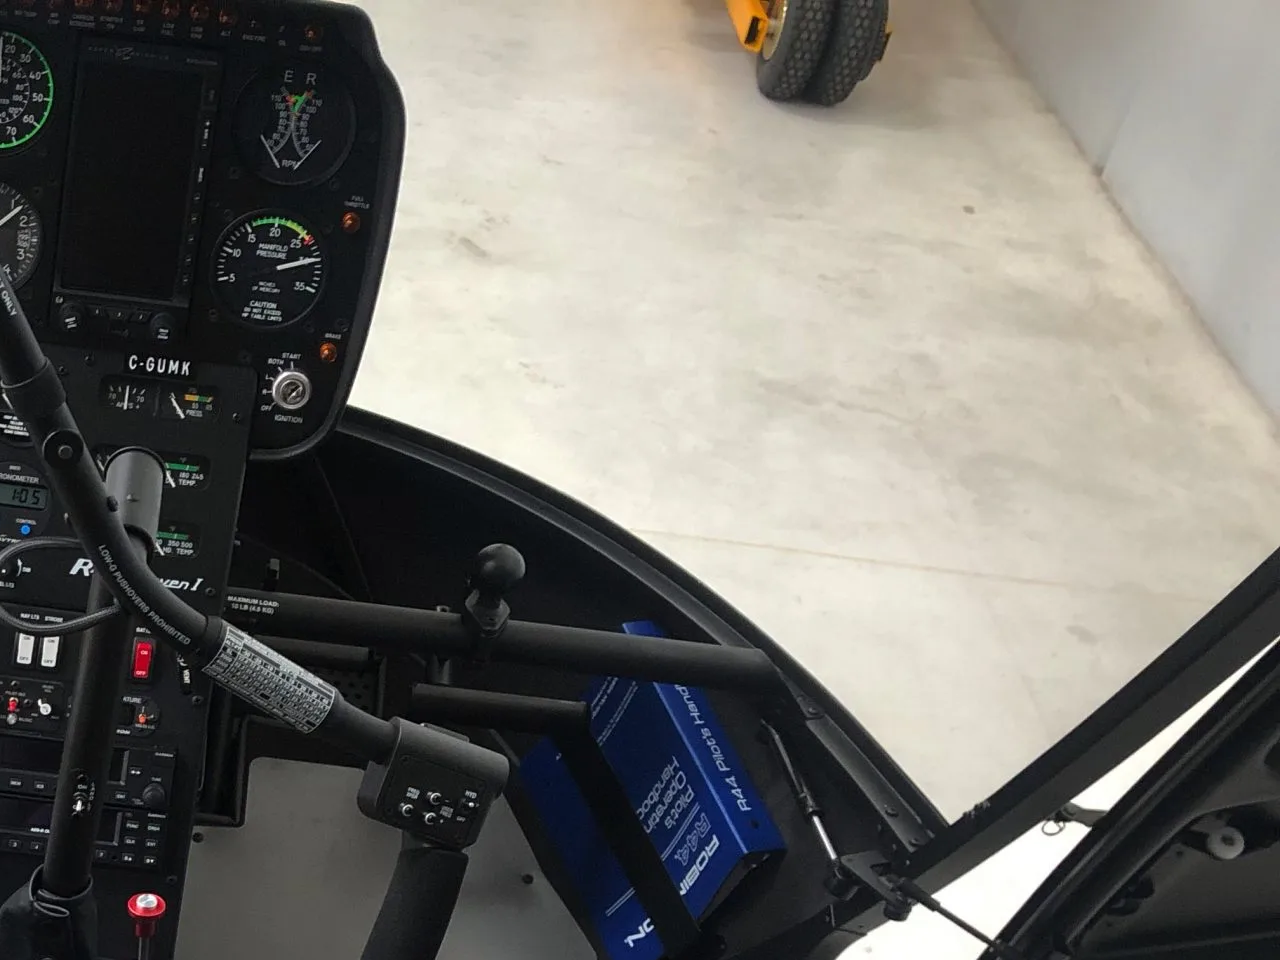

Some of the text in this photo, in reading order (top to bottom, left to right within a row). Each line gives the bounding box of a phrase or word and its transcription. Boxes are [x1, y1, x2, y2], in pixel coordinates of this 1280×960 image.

[5, 44, 16, 54] 20
[19, 54, 31, 63] 30
[29, 71, 42, 81] 40
[284, 70, 295, 82] E
[306, 72, 317, 85] R
[32, 93, 44, 102] 50
[22, 114, 34, 124] 60
[6, 126, 17, 136] 70
[19, 215, 28, 227] 2
[269, 227, 281, 237] 20
[247, 234, 257, 244] 15
[290, 239, 302, 249] 25
[258, 243, 288, 252] MANIFOLD
[16, 248, 25, 260] 3
[232, 249, 242, 258] 10
[256, 250, 287, 260] PRESSURE
[228, 273, 236, 283] 5
[293, 281, 306, 291] 35
[1, 290, 17, 317] ONLY
[250, 300, 277, 309] CAUTION
[282, 352, 302, 360] START
[128, 354, 192, 376] C-GUMK
[274, 414, 303, 424] IGNITION
[113, 571, 150, 613] PUSHOVERS
[148, 611, 191, 645] PROHIBITED
[674, 684, 752, 812] R44 Pilot's Hand
[664, 784, 696, 829] Pilot's
